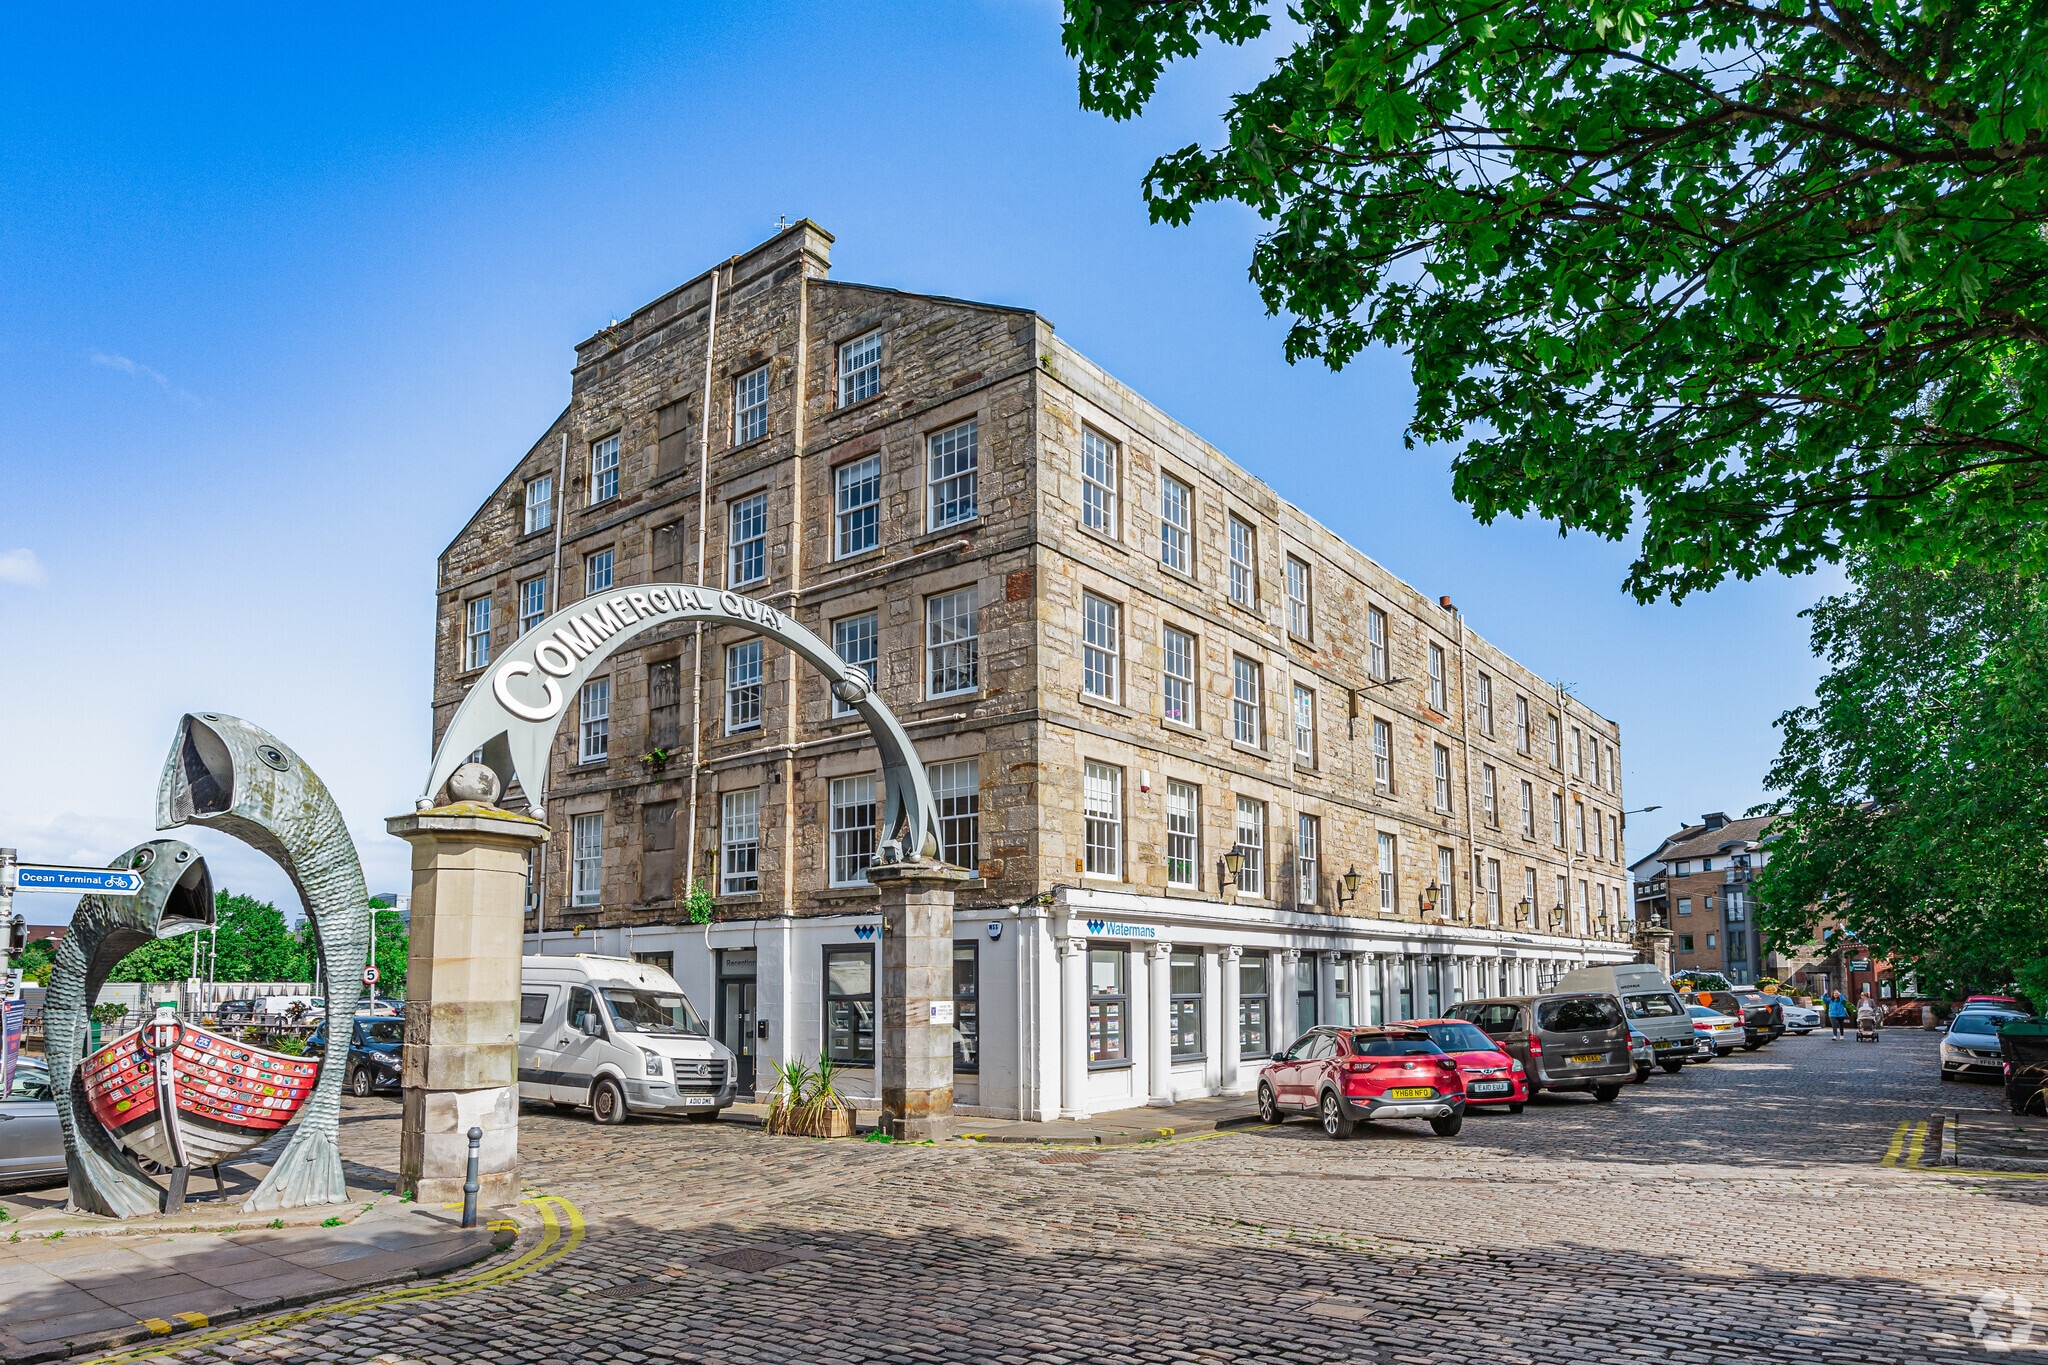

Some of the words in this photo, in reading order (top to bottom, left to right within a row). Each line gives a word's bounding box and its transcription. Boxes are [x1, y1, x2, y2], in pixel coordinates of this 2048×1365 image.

[492, 587, 713, 722] COMMERCIAL
[719, 590, 785, 630] QUAY
[21, 872, 55, 883] Ocean
[58, 874, 102, 885] Terminal
[1106, 920, 1156, 938] Watermans
[726, 959, 757, 969] Reception
[367, 969, 375, 981] 5
[1395, 1089, 1414, 1097] YH68
